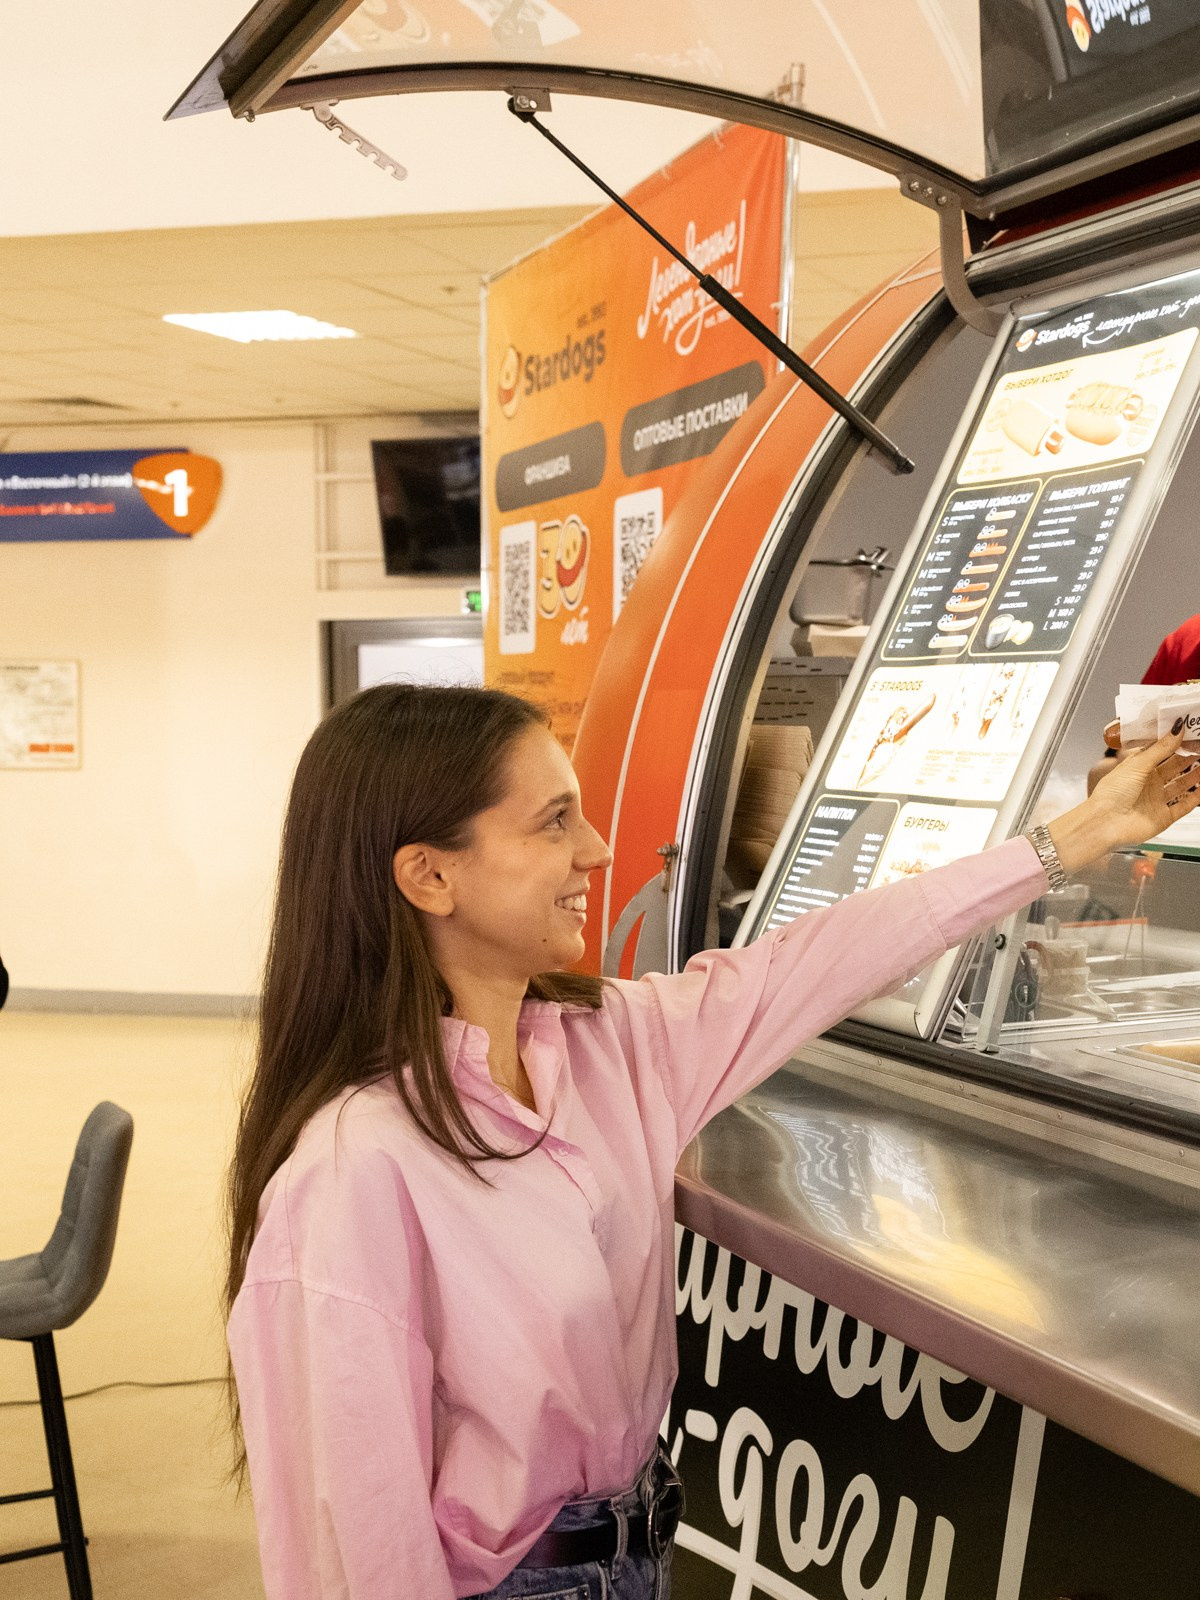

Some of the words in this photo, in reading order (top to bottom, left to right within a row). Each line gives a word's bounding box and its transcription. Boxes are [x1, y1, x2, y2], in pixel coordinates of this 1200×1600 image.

[1034, 319, 1093, 346] Stardogs
[525, 329, 606, 396] Stardogs
[686, 391, 748, 436] ПОСТАВКИ
[165, 469, 193, 518] 1
[904, 816, 949, 832] БУРГЕРЫ
